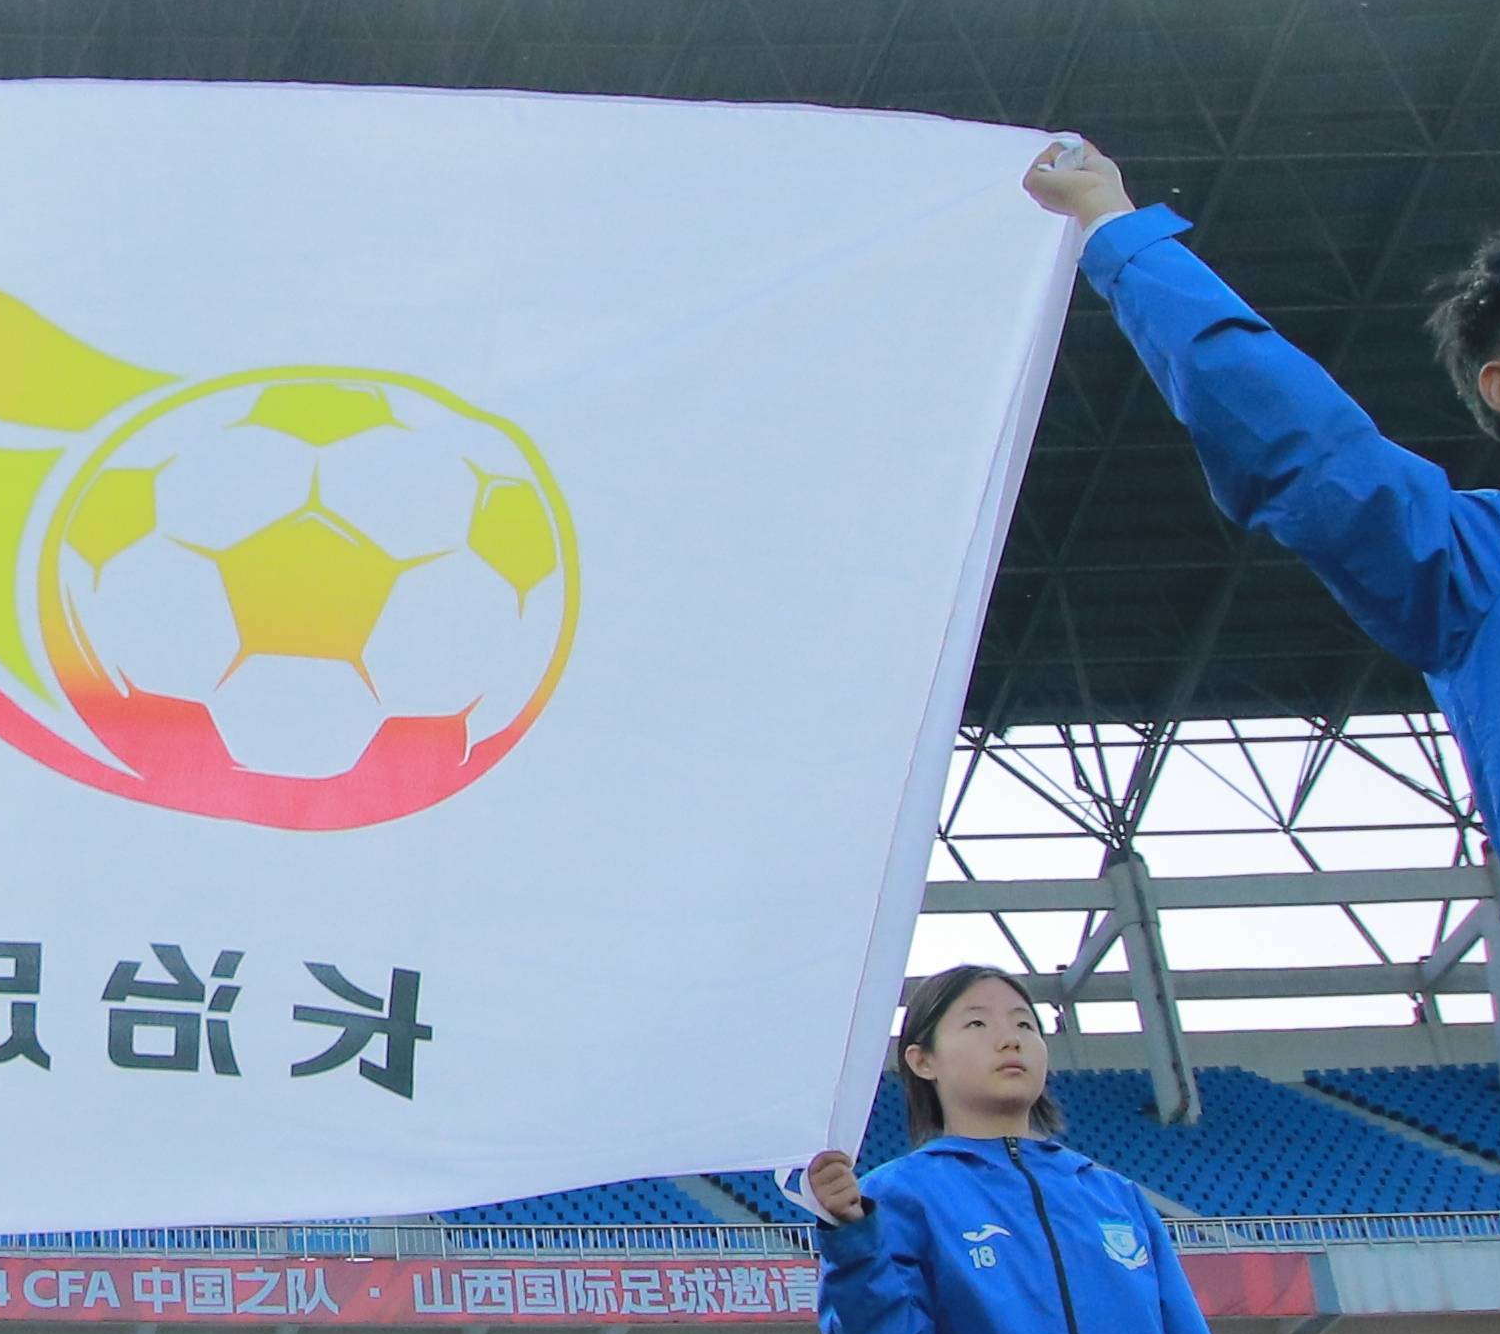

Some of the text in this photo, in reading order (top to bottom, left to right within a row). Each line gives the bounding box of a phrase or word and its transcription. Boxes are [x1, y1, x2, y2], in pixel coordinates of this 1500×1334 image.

[968, 1244, 998, 1270] 18
[22, 1269, 121, 1309] CFA
[133, 1267, 340, 1316] 中国之队
